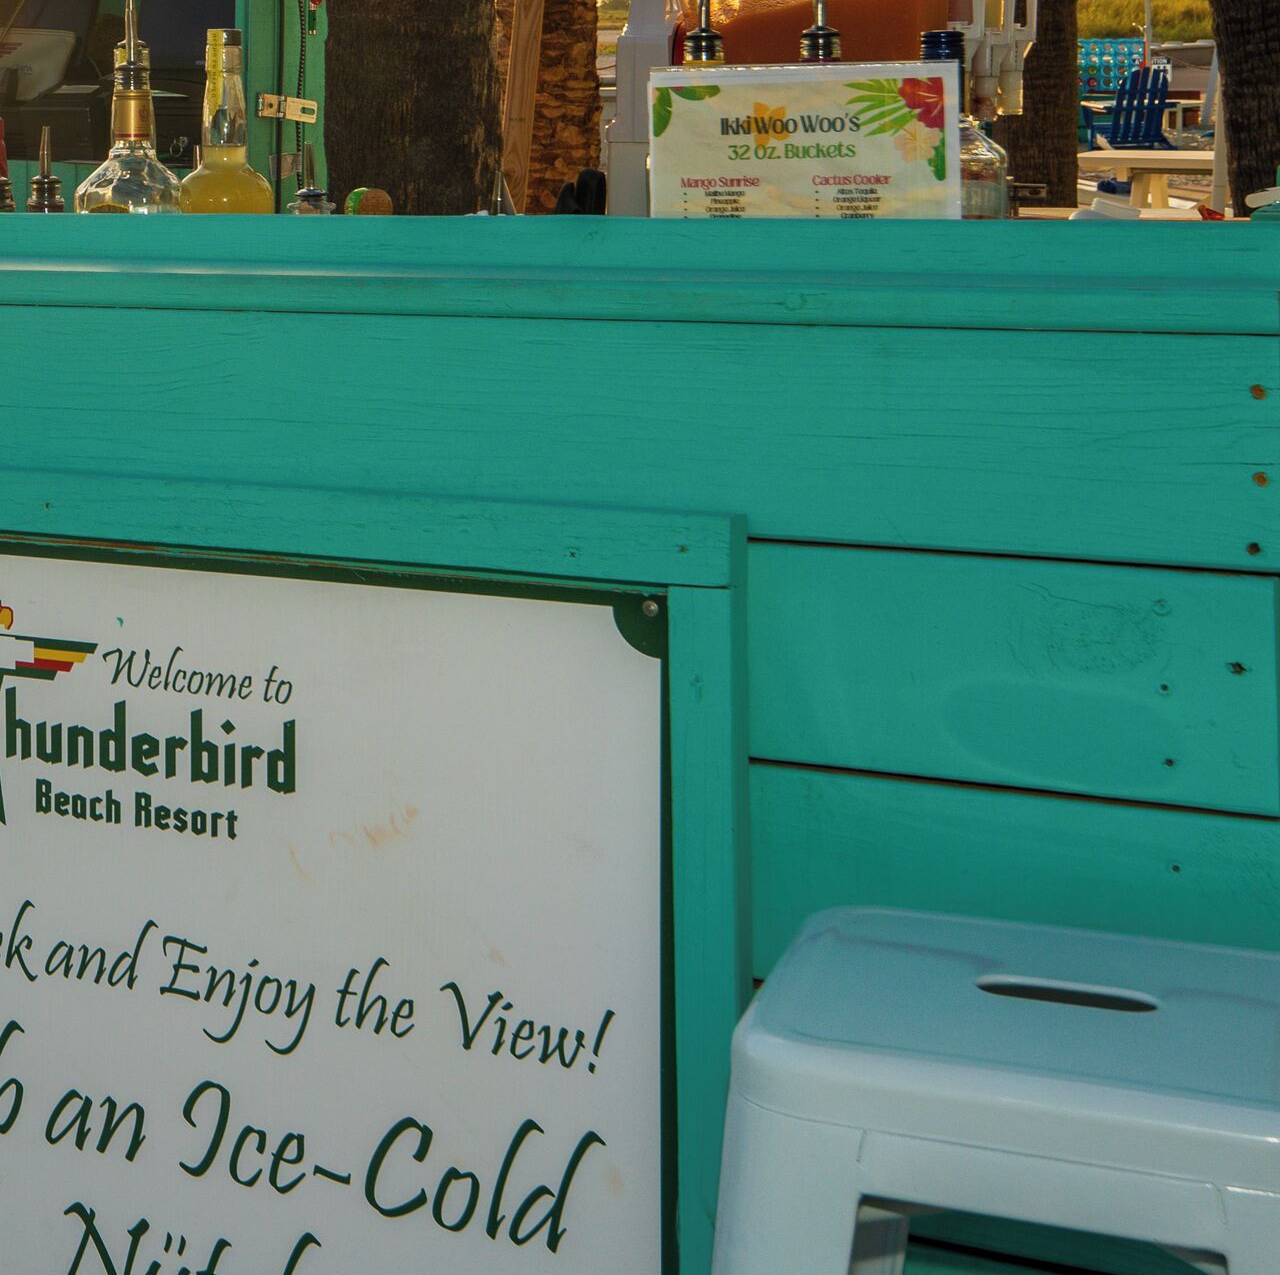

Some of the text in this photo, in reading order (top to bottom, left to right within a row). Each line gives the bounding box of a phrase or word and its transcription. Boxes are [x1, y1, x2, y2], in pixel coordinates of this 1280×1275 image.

[753, 116, 797, 134] Woo
[800, 113, 860, 133] Woo's
[728, 144, 751, 160] 32
[784, 141, 856, 159] Buckets
[680, 175, 760, 190] Mango Sunrise
[812, 173, 892, 185] Cactus Cooler
[102, 646, 294, 706] Welcome to
[35, 777, 239, 841] Beach Resort
[44, 920, 159, 991] and
[159, 934, 317, 1056] Enjoy
[335, 956, 416, 1039] the
[438, 981, 617, 1075] View!
[45, 1088, 146, 1162] an
[178, 1079, 606, 1255] Ice-Cold
